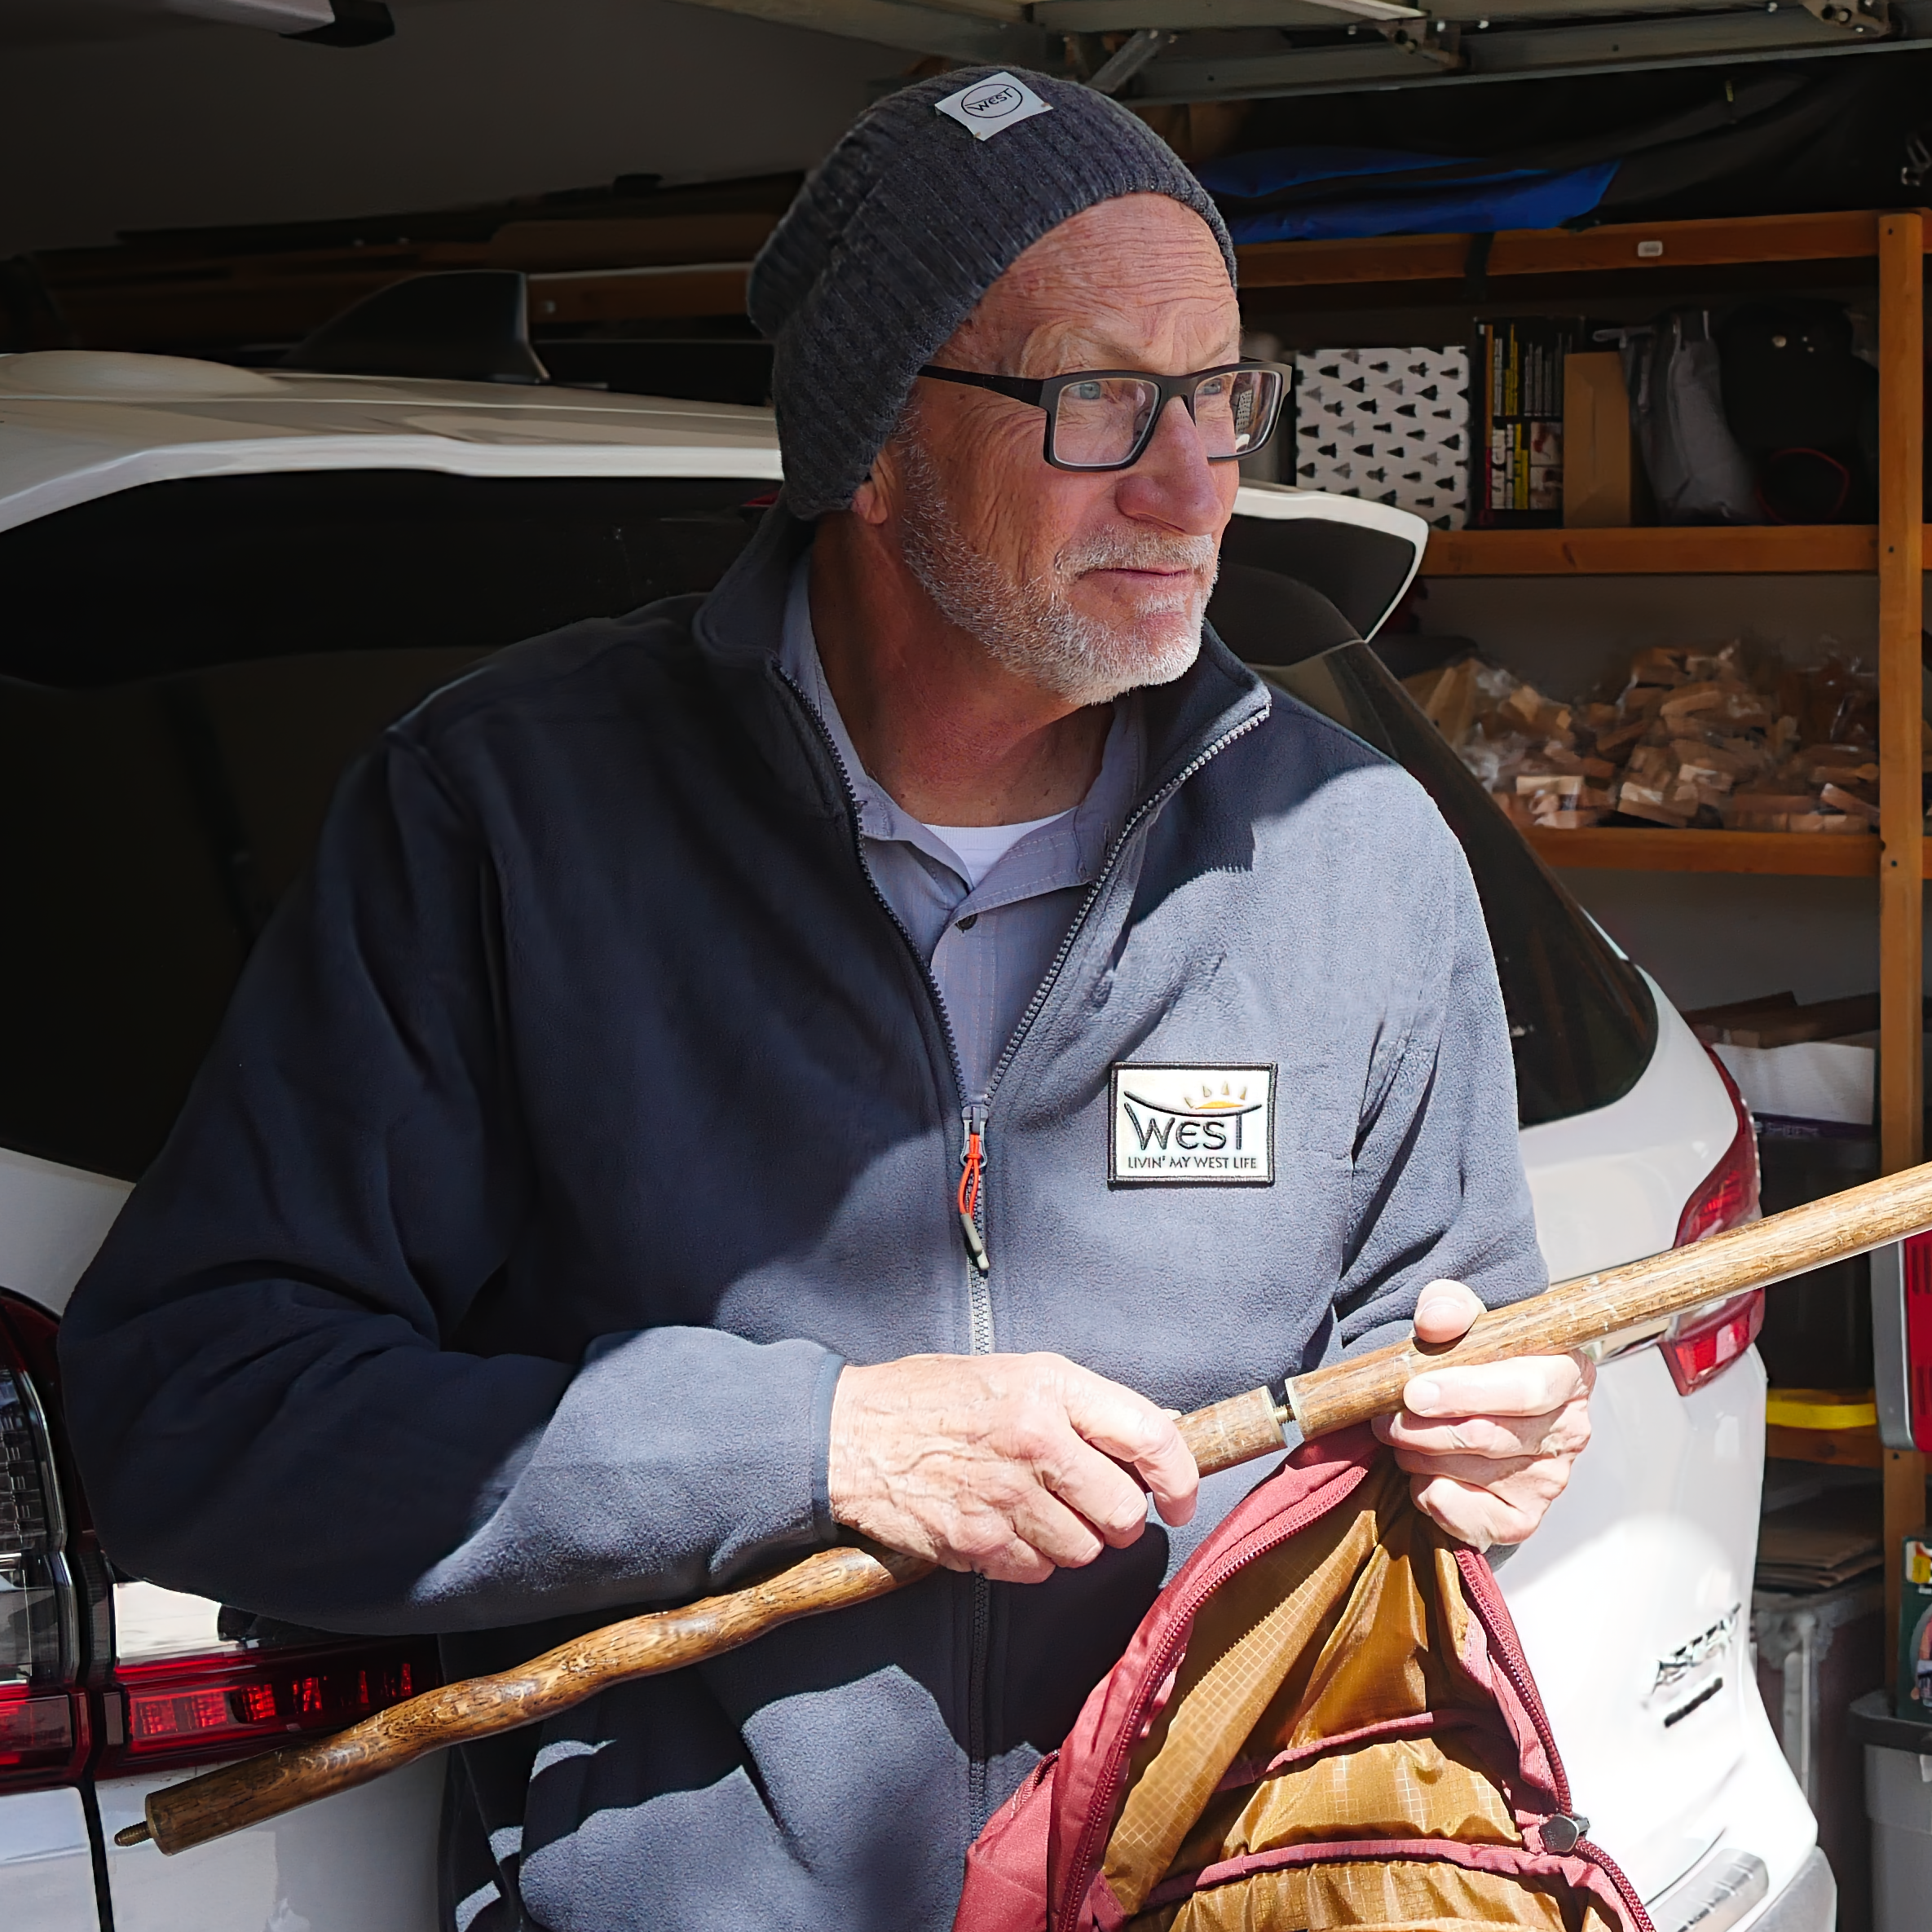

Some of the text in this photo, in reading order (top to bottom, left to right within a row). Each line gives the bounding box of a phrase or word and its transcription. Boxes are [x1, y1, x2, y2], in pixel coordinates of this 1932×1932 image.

[964, 87, 1013, 112] WEST
[1128, 1155, 1257, 1169] LIVIN' MY WEST LIFE
